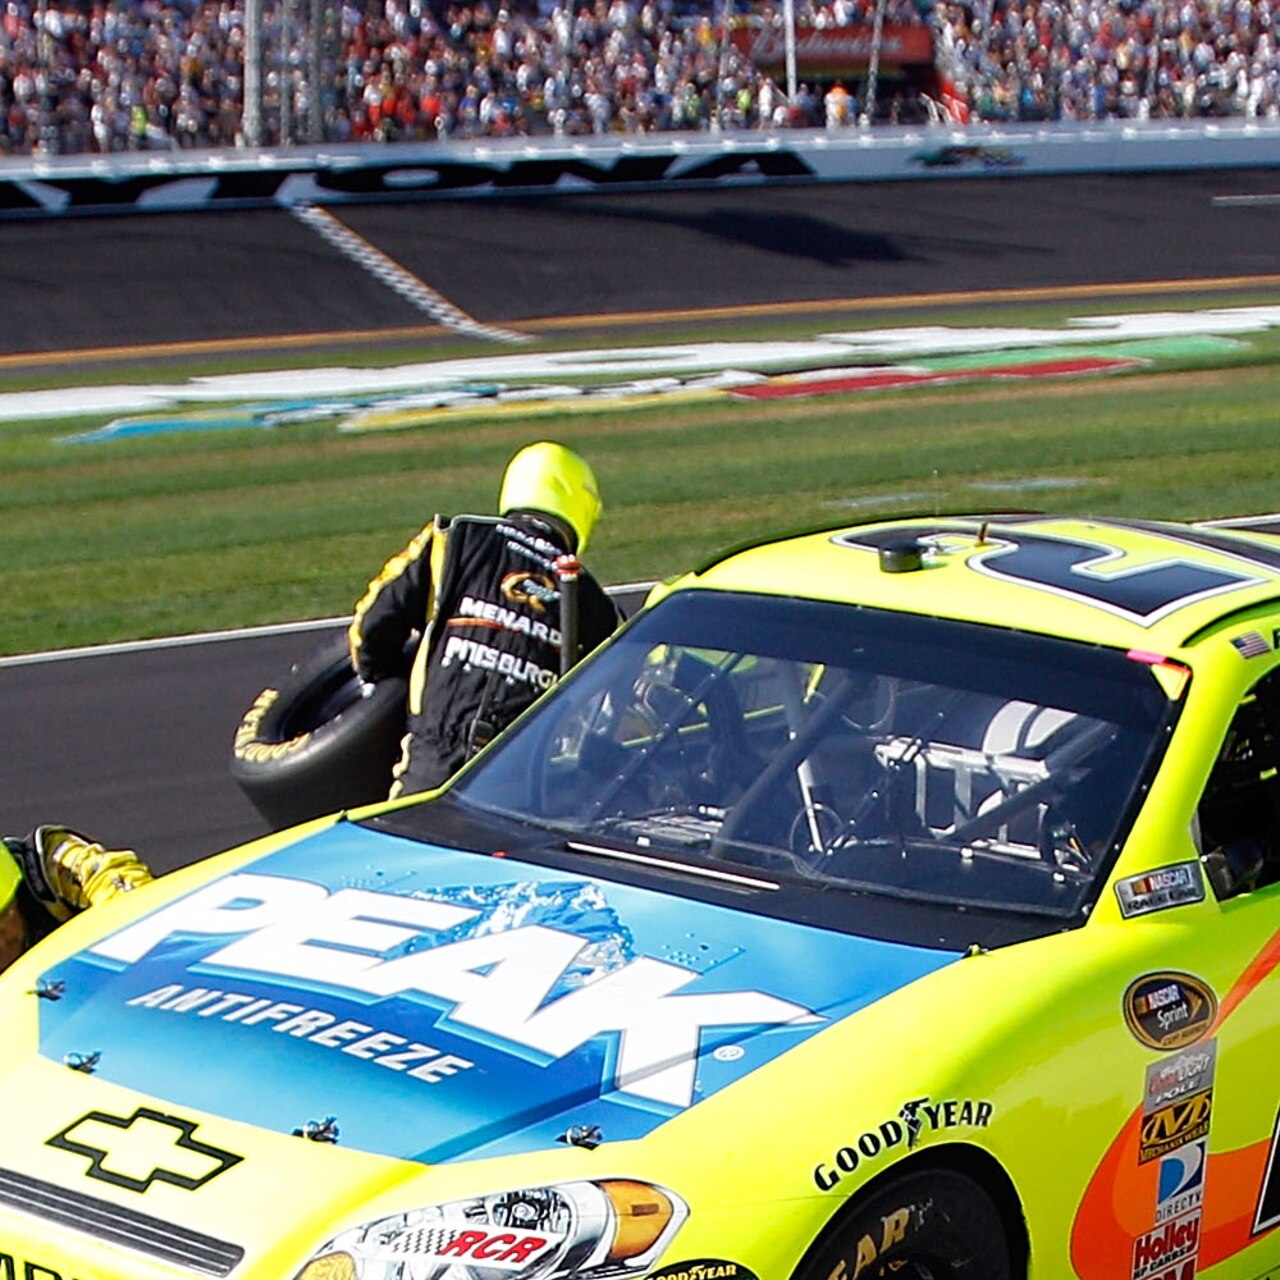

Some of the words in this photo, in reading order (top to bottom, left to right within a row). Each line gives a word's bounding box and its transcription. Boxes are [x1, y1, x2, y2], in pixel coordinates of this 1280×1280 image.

[459, 597, 563, 644] MENARD
[89, 872, 830, 1109] PEAK
[1157, 1003, 1189, 1030] Sprint
[126, 984, 475, 1084] ANTIFREEZE
[813, 1097, 993, 1193] GOODYEAR
[437, 1230, 548, 1263] RCR
[1134, 1216, 1200, 1270] Holley
